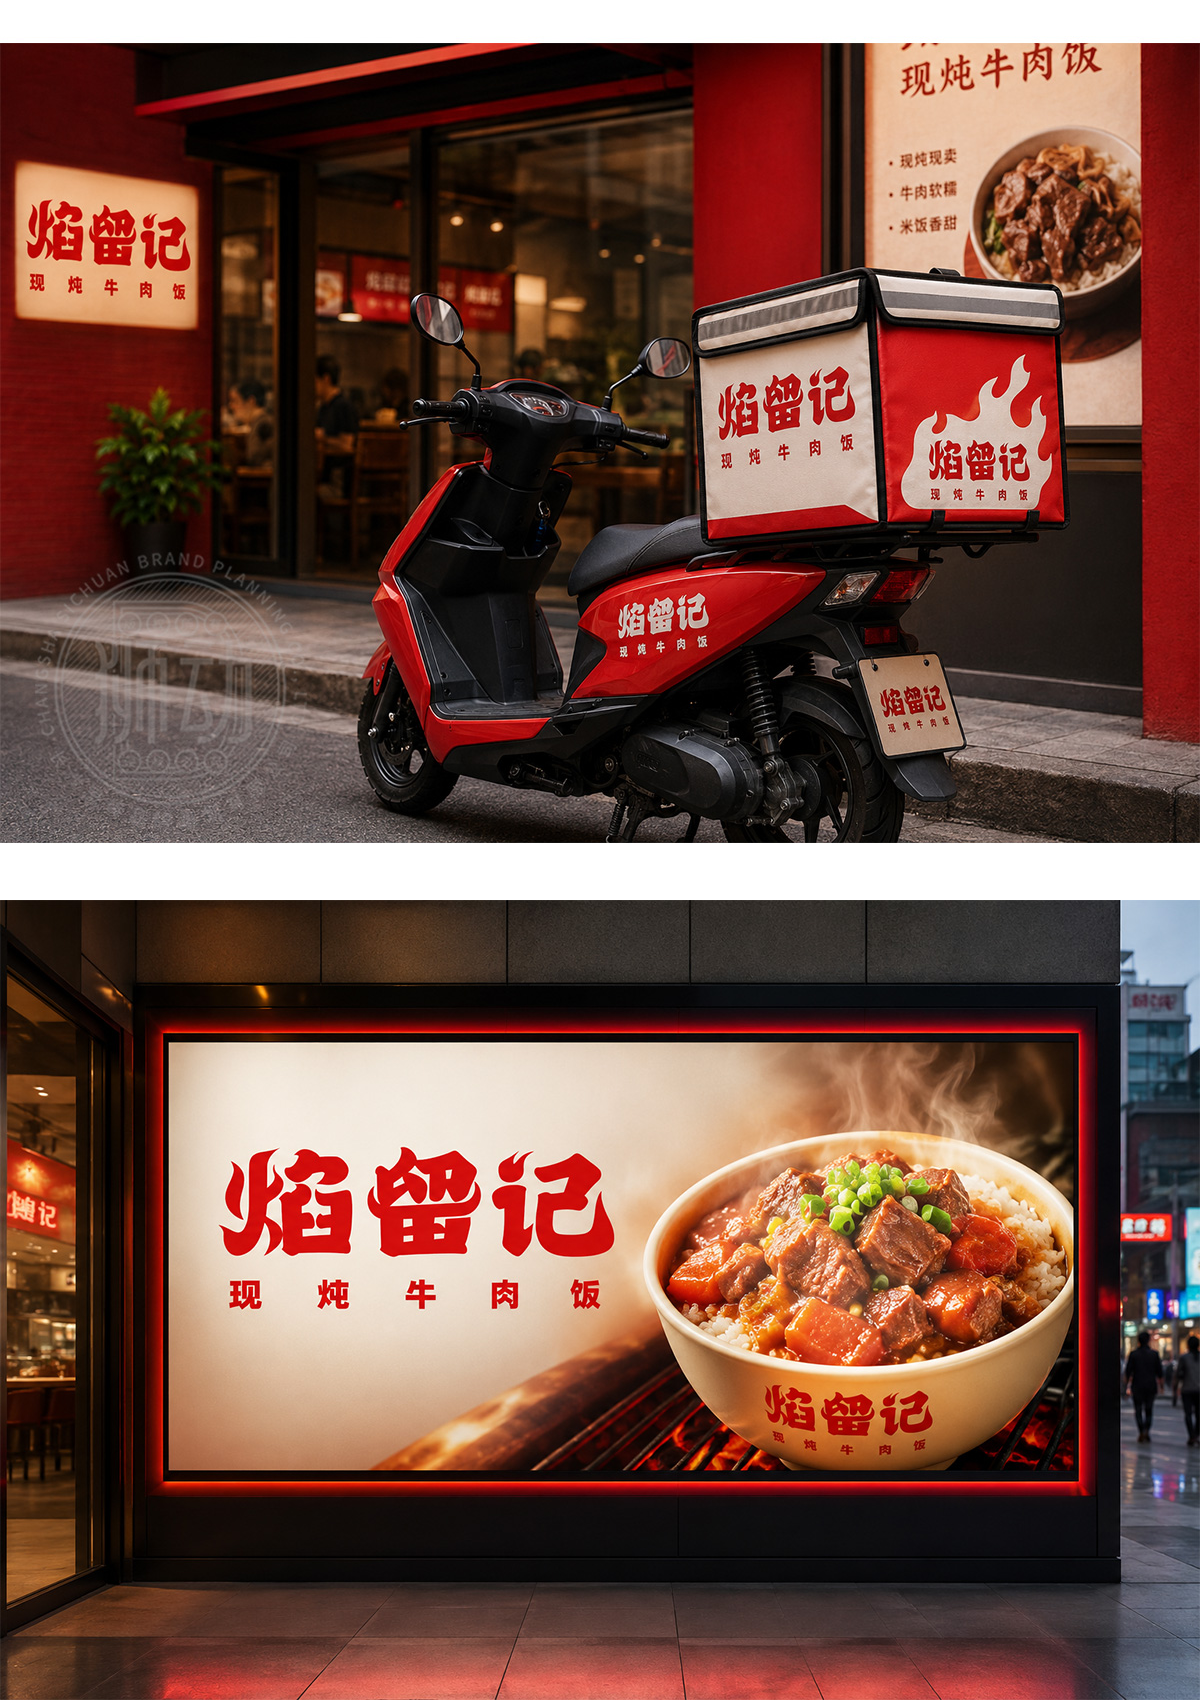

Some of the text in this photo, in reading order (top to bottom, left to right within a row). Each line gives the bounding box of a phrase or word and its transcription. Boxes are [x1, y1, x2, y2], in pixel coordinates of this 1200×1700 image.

[901, 43, 1102, 96] 现炖牛肉饭
[900, 148, 956, 168] 现炖现卖
[901, 181, 957, 201] 牛肉软糯
[27, 200, 190, 271] 焰留记
[900, 215, 957, 234] 米饭香甜
[30, 274, 185, 300] 现炖牛肉饭
[719, 366, 855, 440] 焰留记
[721, 434, 853, 469] 现炖牛肉饭
[929, 440, 1030, 481] 焰留记
[931, 489, 1027, 501] 现炖牛肉饭
[618, 593, 709, 638] 焰留记
[620, 636, 707, 657] 现炖牛肉饭
[880, 685, 946, 717] 焰留记
[888, 716, 949, 732] 现炖牛肉饭
[219, 1147, 614, 1257] 焰留记
[229, 1279, 600, 1309] 现炖牛肉饭
[765, 1385, 932, 1436] 焰留记
[773, 1431, 918, 1454] 现炖牛肉饭
